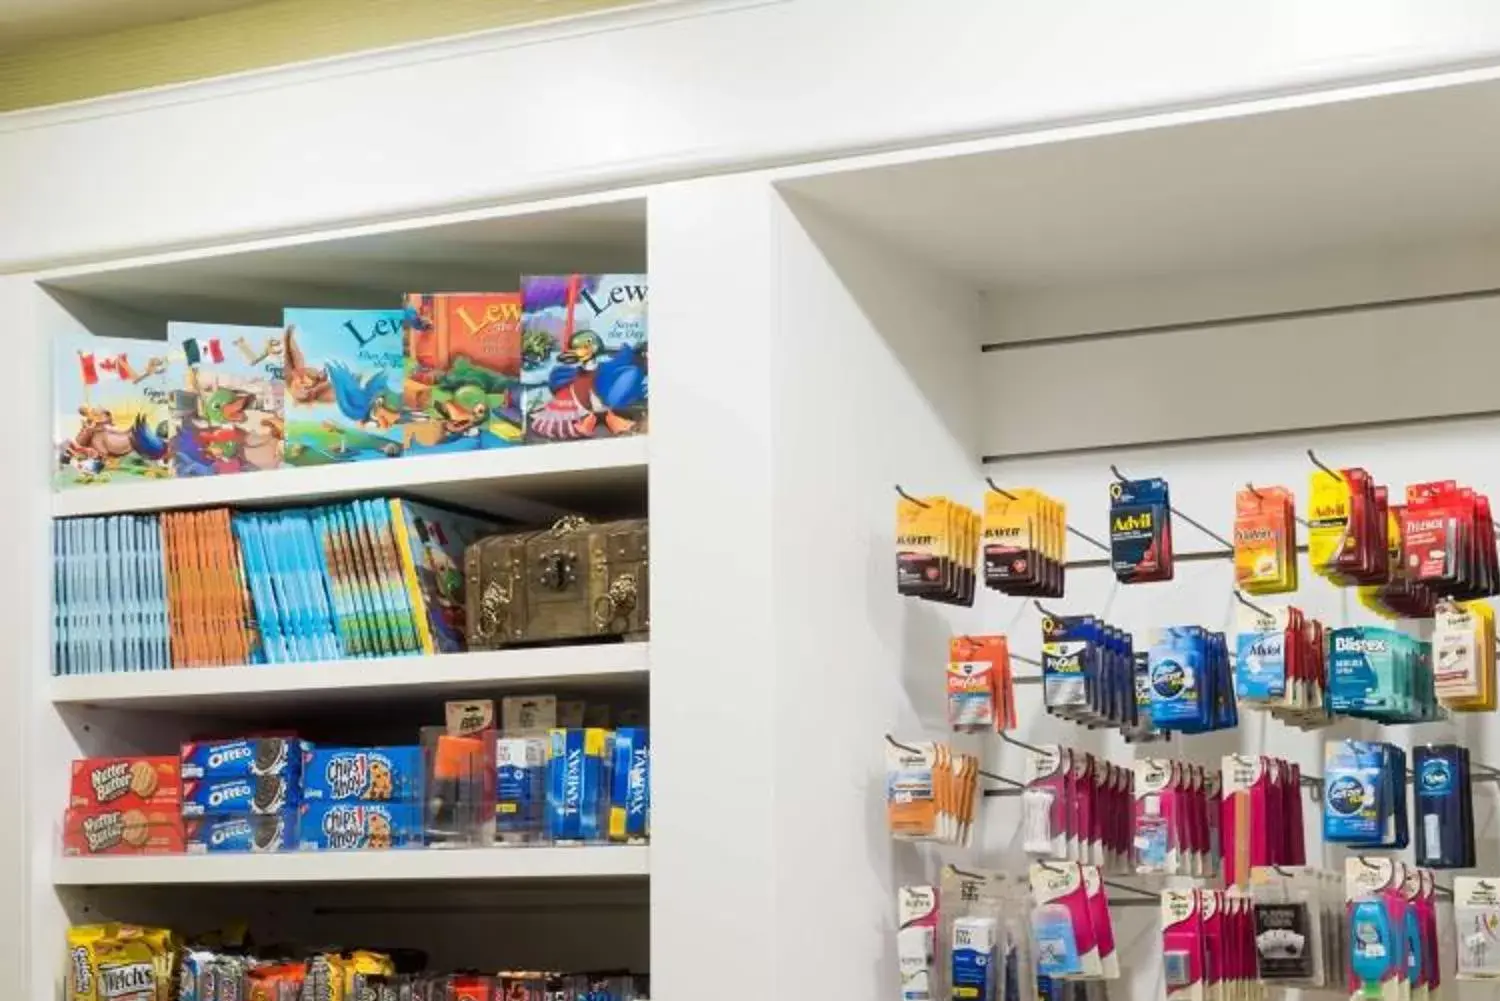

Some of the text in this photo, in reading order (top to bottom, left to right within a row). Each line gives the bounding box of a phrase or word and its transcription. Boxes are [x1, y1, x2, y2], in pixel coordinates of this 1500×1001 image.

[1113, 515, 1152, 532] Advil
[208, 747, 252, 768] OREO
[208, 785, 251, 805] OREO
[101, 966, 153, 993] Welch's
